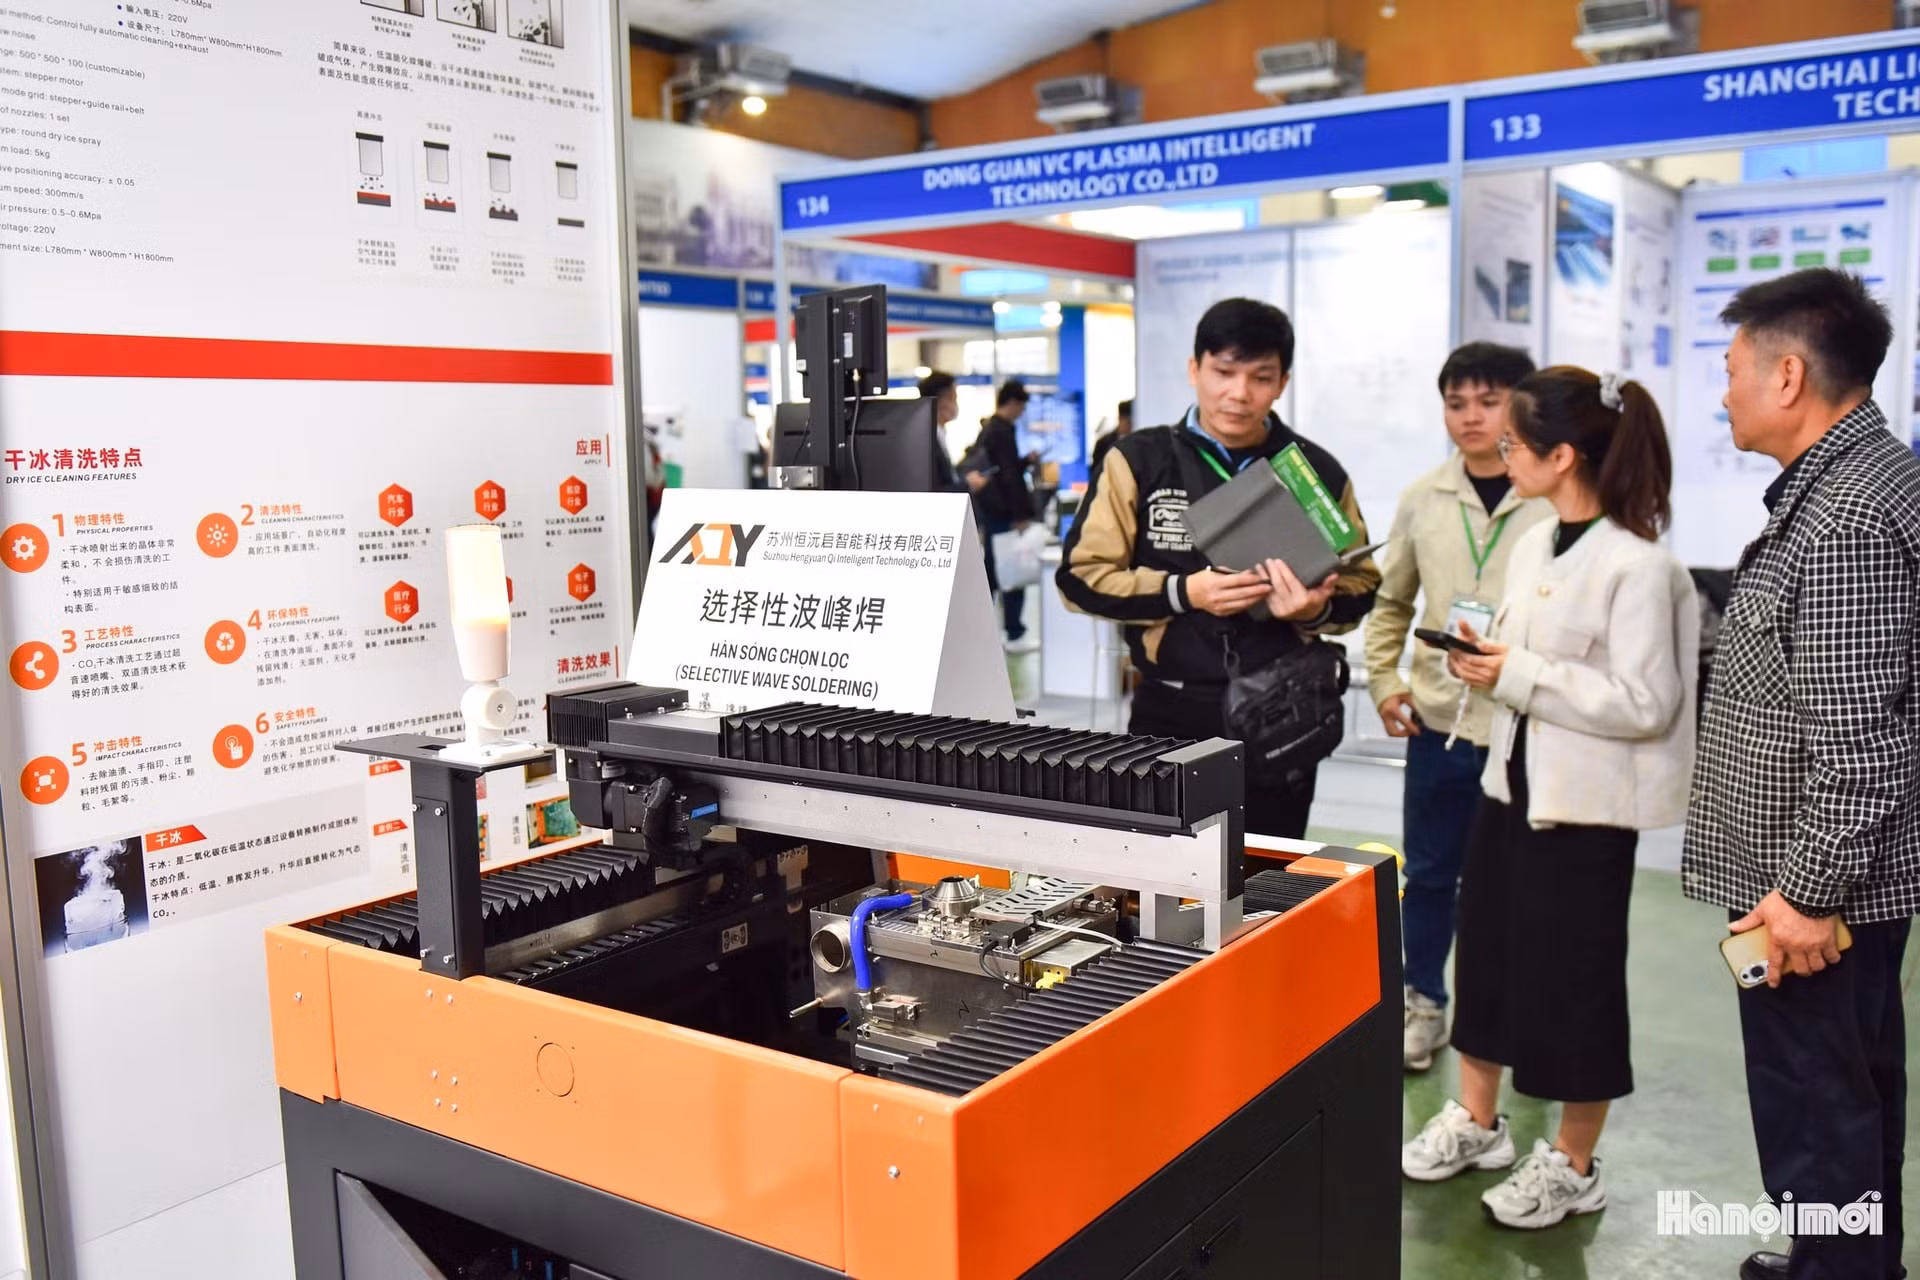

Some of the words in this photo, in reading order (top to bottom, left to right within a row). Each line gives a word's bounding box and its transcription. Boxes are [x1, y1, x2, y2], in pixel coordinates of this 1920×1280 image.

[9, 9, 44, 23] method:
[46, 16, 78, 29] Control
[80, 23, 97, 34] fully
[100, 27, 139, 41] automatic
[12, 30, 36, 40] noise
[19, 51, 36, 60] 500
[44, 55, 60, 64] 500
[68, 59, 84, 68] 100
[85, 62, 146, 80] (customizable)
[24, 71, 57, 83] stepper
[59, 77, 84, 87] motor
[1703, 55, 1881, 102] SHANGHAI
[1887, 51, 1920, 81] LI
[1, 87, 26, 97] mode
[28, 90, 47, 101] grid:
[50, 94, 110, 109] stepper+guide
[111, 104, 145, 115] rail+belt
[1832, 85, 1920, 120] TECH
[11, 108, 47, 119] nozzles:
[57, 115, 70, 123] set
[1490, 113, 1542, 142] 133
[21, 130, 46, 139] round
[48, 132, 62, 142] dry
[64, 134, 76, 142] ice
[78, 137, 101, 147] spray
[11, 146, 32, 155] load:
[34, 149, 50, 159] 5kg
[923, 163, 983, 191] DONG
[983, 157, 1044, 185] GUAN
[1044, 152, 1071, 179] VC
[1072, 141, 1162, 175] PLASMA
[1164, 123, 1316, 161] INTELLIGENT
[14, 166, 62, 180] positioning
[64, 172, 104, 184] accuracy:
[117, 177, 135, 187] 0.05
[13, 186, 43, 196] speed:
[45, 189, 84, 200] 300mm/s
[990, 173, 1131, 209] TECHNOLOGY
[8, 205, 50, 215] pressure:
[797, 196, 830, 217] 134
[33, 226, 56, 235] 220V
[23, 245, 43, 253] size:
[45, 245, 82, 256] L780mm
[89, 249, 127, 259] W800mm
[134, 253, 174, 263] H1800mm
[576, 439, 602, 455] 应用
[5, 447, 143, 471] 干冰清洗特点
[6, 476, 25, 484] DRY
[27, 475, 42, 483] ICE
[44, 473, 90, 482] CLEANING
[91, 472, 137, 481] FEATURES
[387, 494, 404, 505] 汽车
[483, 502, 499, 512] 行业
[240, 504, 255, 526] 2
[259, 503, 303, 516] 清洁特性
[388, 506, 405, 518] 行业
[52, 513, 65, 537] 1
[74, 512, 125, 527] 物理特性
[261, 516, 291, 524] CLEANING
[291, 514, 344, 523] CHARACTERISTICS
[76, 527, 110, 535] PHYSICAL
[111, 525, 153, 533] PROPERTIES
[766, 531, 955, 553] 苏州恒沅启智能科技有限公司
[763, 551, 790, 561] Suzhou
[790, 552, 826, 565] Hengyuan
[828, 553, 836, 565] Qi
[837, 554, 874, 567] Intelligent
[876, 555, 919, 569] Technology
[938, 558, 951, 568] Ltd
[393, 590, 410, 601] 医疗
[267, 606, 310, 621] 环保特性
[394, 602, 411, 614] 行业
[699, 587, 886, 634] 选择性波峰焊
[247, 609, 262, 631] 4
[268, 619, 311, 629] ECO-FRIENDLY
[311, 615, 341, 624] FEATURES
[61, 629, 78, 653] 3
[84, 624, 134, 642] 工艺特性
[85, 641, 119, 650] PROCESS
[119, 633, 181, 646] CHARACTERISTICS
[557, 651, 611, 674] 清洗效果
[710, 638, 738, 660] HÀN
[739, 641, 777, 664] SÓNG
[779, 647, 819, 670] CHỌN
[821, 651, 850, 673] LỌC
[558, 674, 586, 684] CLEANING
[586, 670, 607, 679] EFFECT
[675, 663, 750, 686] (SELECTIVE
[752, 669, 789, 691] WAVE
[791, 675, 879, 702] SOLDERING)
[255, 712, 270, 734] 6
[274, 706, 317, 723] 安全特性
[276, 721, 299, 731] SAFETY
[299, 716, 328, 727] FEATURES
[93, 735, 143, 753] 冲击特性
[95, 752, 121, 761] IMPACT
[121, 741, 182, 757] CHARACTERISTICS
[71, 742, 88, 767] 5
[156, 830, 183, 847] 干冰
